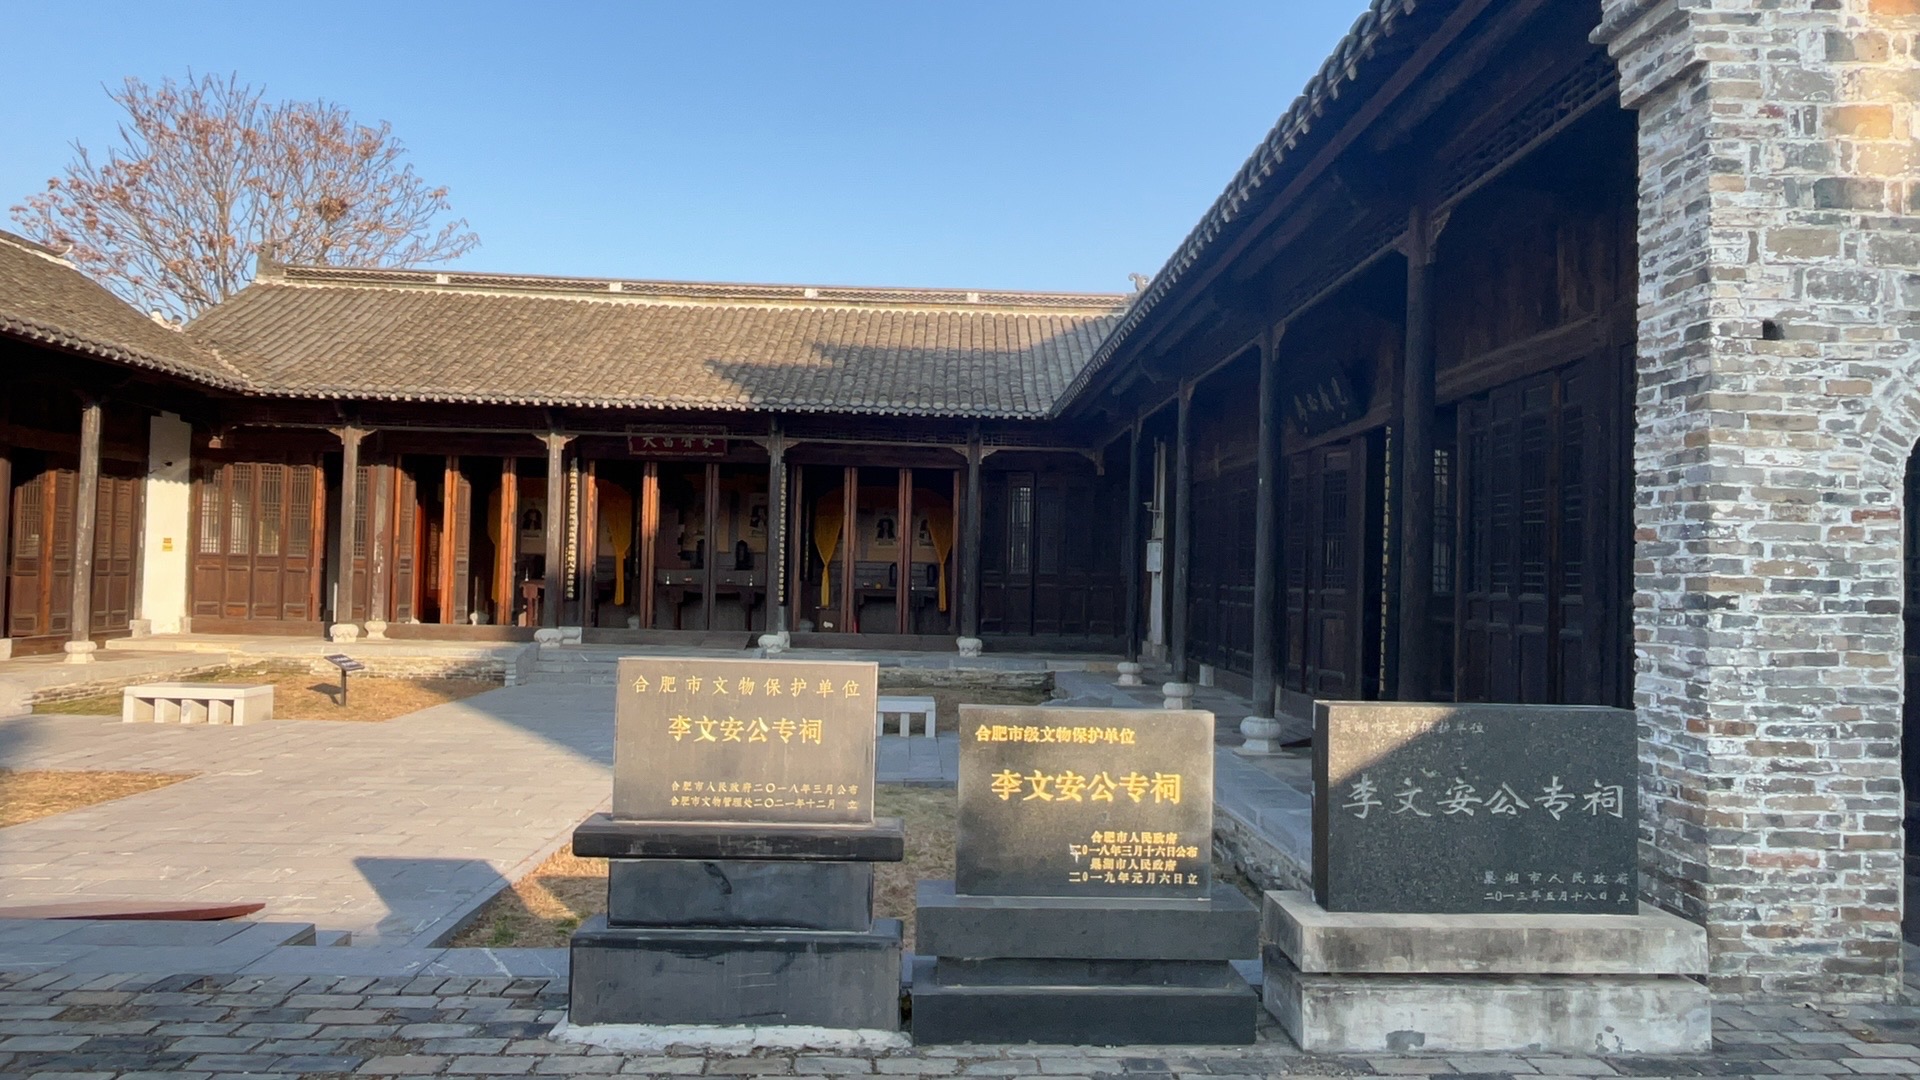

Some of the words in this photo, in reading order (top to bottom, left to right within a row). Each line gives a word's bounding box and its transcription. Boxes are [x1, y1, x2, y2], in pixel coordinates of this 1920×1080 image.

[632, 674, 861, 698] 合肥市文物保护单位
[668, 715, 823, 745] 李文安公专祠
[975, 724, 1136, 745] 合肥市级文物保护单位
[991, 769, 1182, 804] 李文安公专祠
[1342, 773, 1624, 820] 李文安公专祠
[1091, 830, 1178, 845] 合肥市人民政府
[1090, 858, 1177, 872] 巢湖市人民政府
[1483, 870, 1629, 885] 巢湖市人民政府
